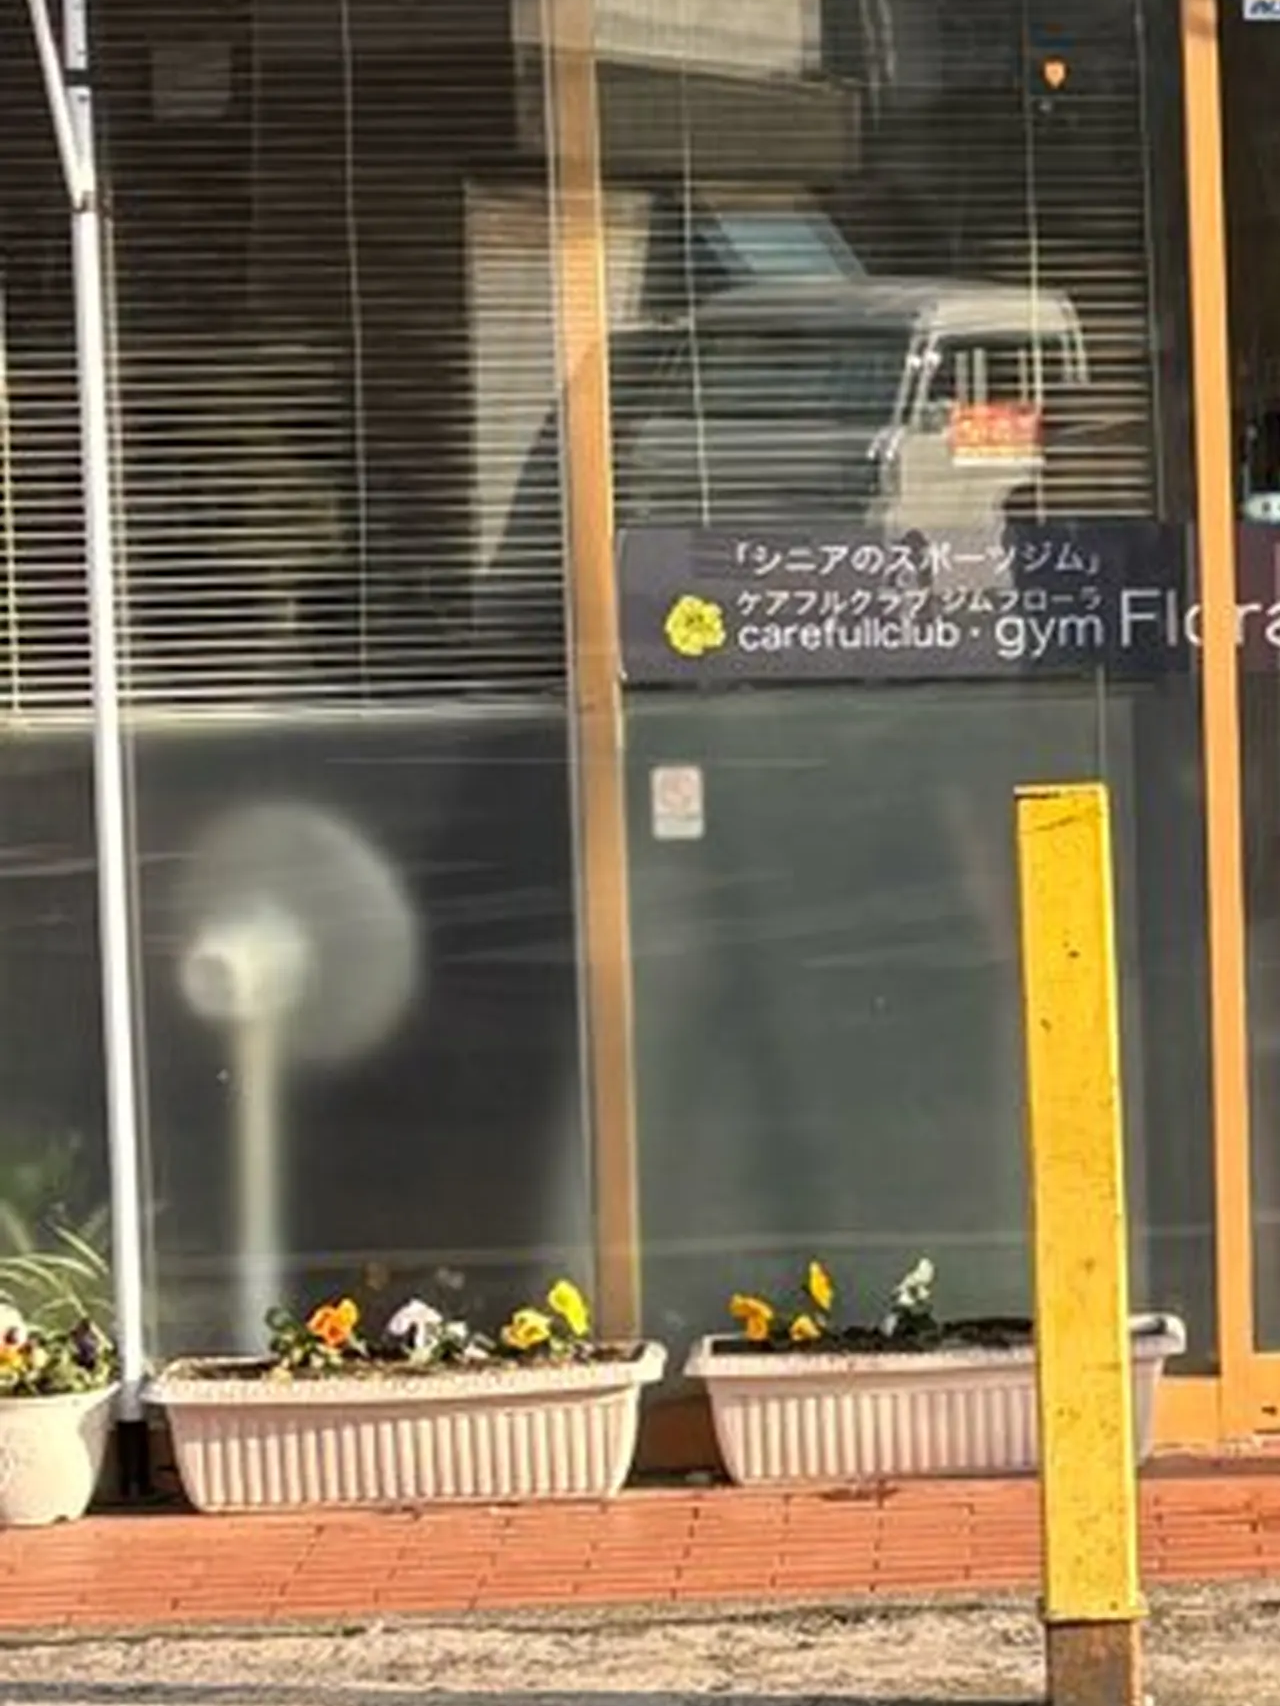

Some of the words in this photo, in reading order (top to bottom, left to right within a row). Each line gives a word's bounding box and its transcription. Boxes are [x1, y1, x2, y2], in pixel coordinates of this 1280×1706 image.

[736, 586, 930, 617] ケアフルクラブ
[737, 615, 960, 652] carefullclub
[994, 613, 1104, 661] gym
